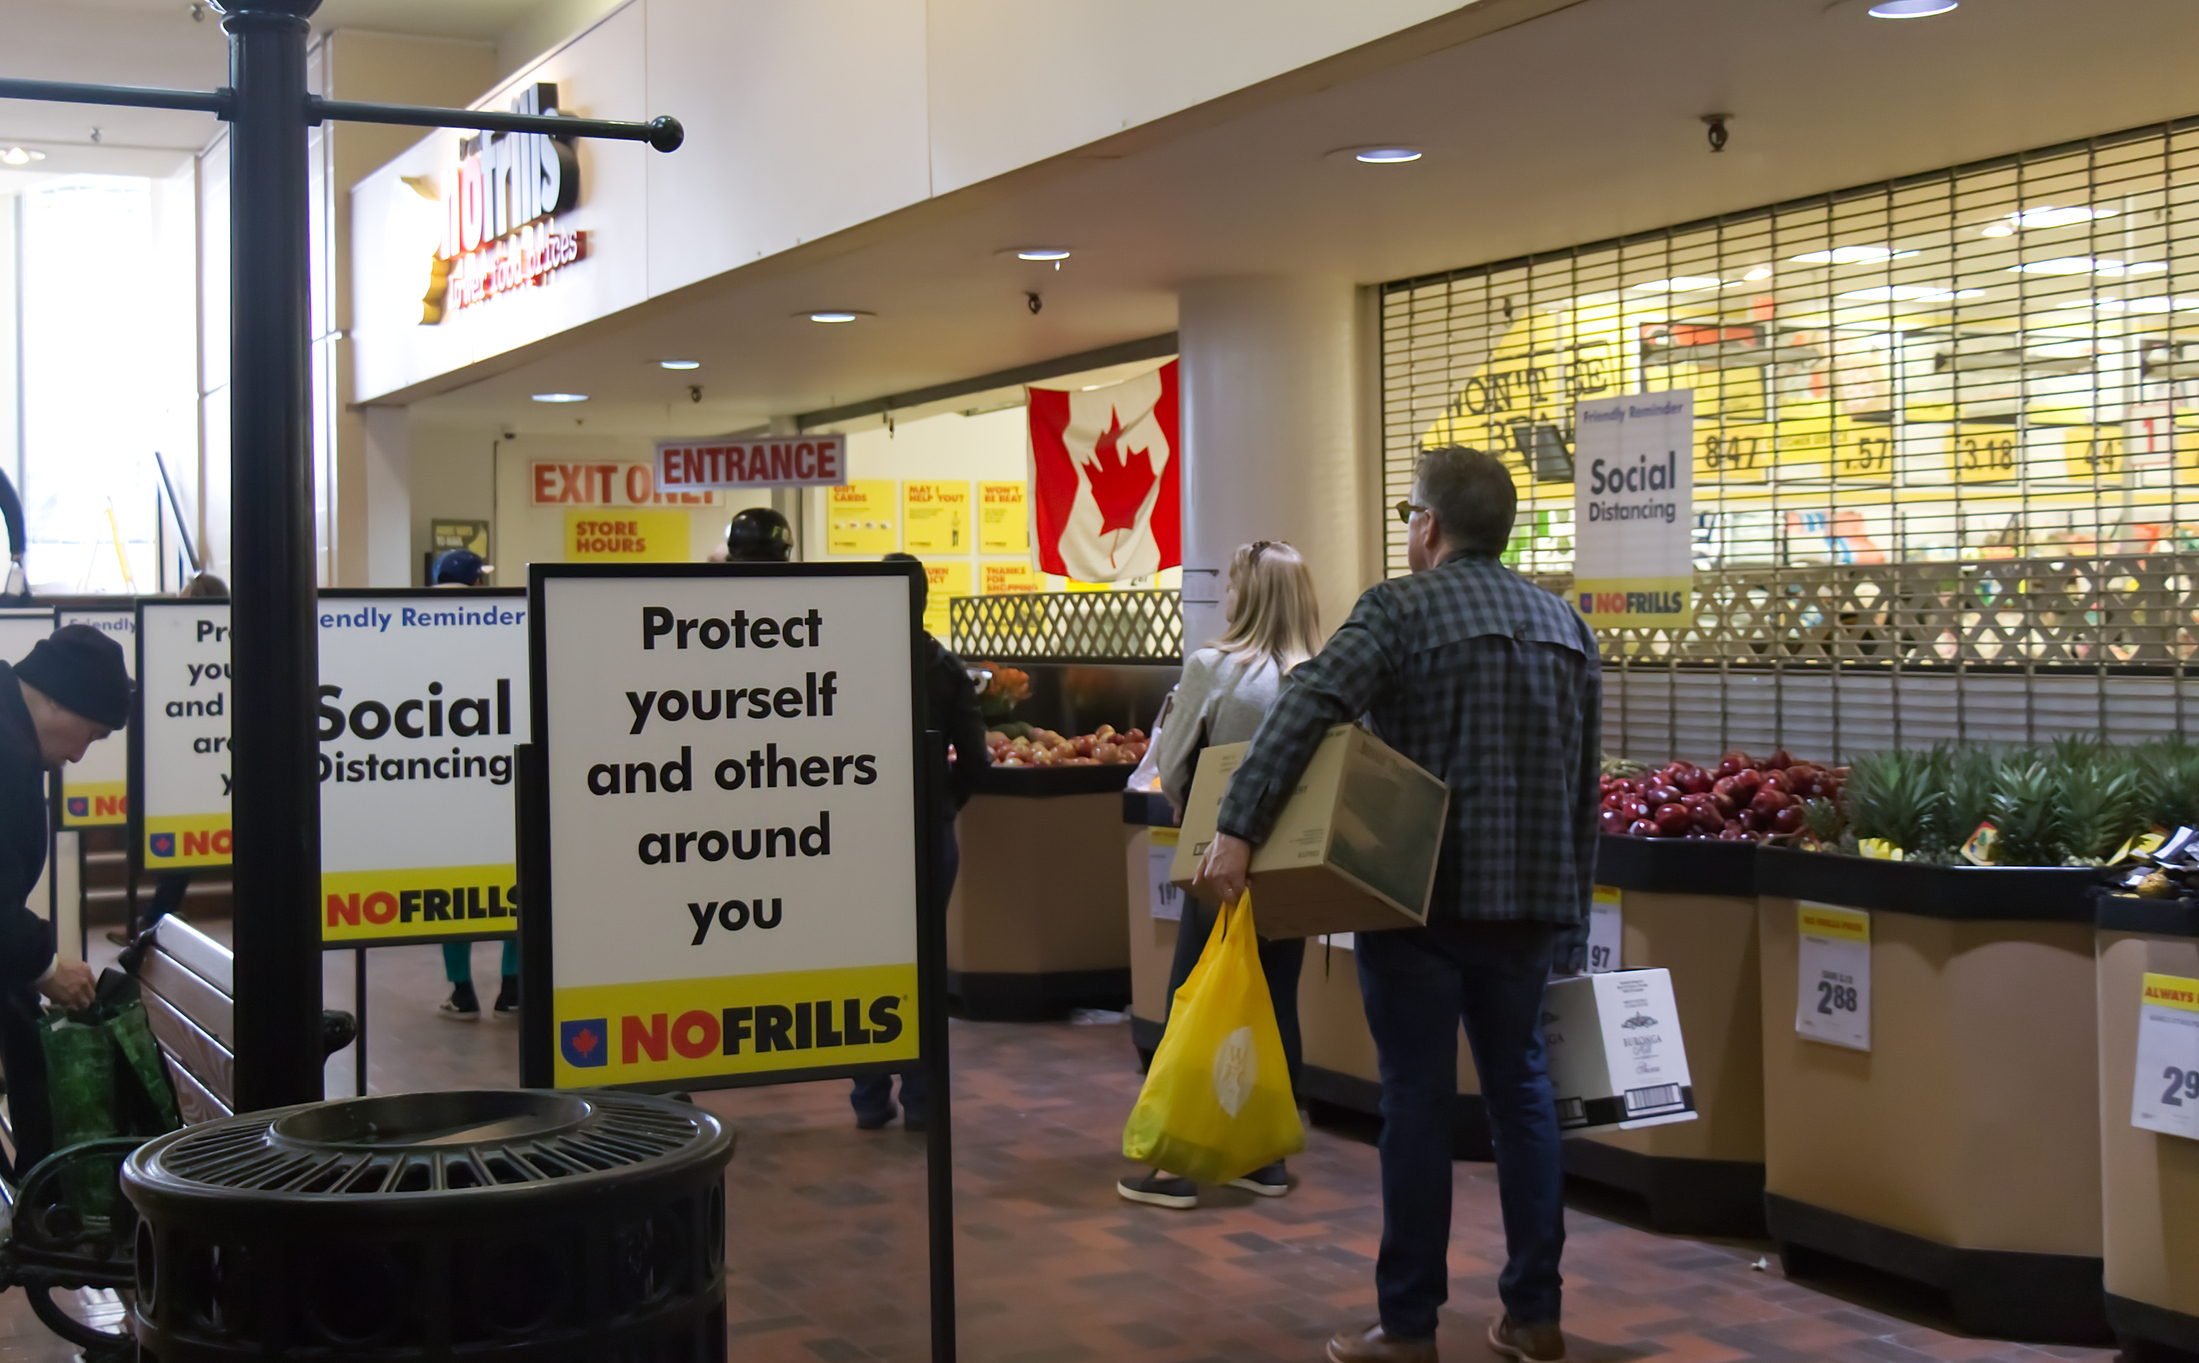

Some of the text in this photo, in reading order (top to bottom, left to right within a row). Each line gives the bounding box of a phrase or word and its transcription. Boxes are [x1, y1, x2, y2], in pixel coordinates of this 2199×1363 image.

[1628, 400, 1683, 419] Reminder
[663, 442, 836, 485] ENTRANCE
[1590, 451, 1676, 495] Social
[534, 463, 618, 504] EXIT
[909, 485, 932, 494] MAY
[909, 493, 964, 502] HELP YOU?
[1589, 498, 1677, 524] Distancing
[576, 521, 638, 536] STORE
[576, 538, 646, 553] HOURS
[986, 566, 1026, 575] THANKS
[986, 575, 1006, 583] FOR
[1596, 591, 1683, 614] NOFRILLS
[402, 605, 527, 627] Reminder
[641, 605, 823, 650] Protect
[165, 692, 224, 718] and
[318, 677, 512, 742] Social
[625, 670, 838, 735] yourself
[587, 743, 878, 796] and others
[638, 810, 832, 865] around
[687, 897, 783, 946] you
[1817, 980, 1858, 1015] 288
[2144, 985, 2195, 1003] ALWAYS
[620, 995, 903, 1066] NOFRILLS
